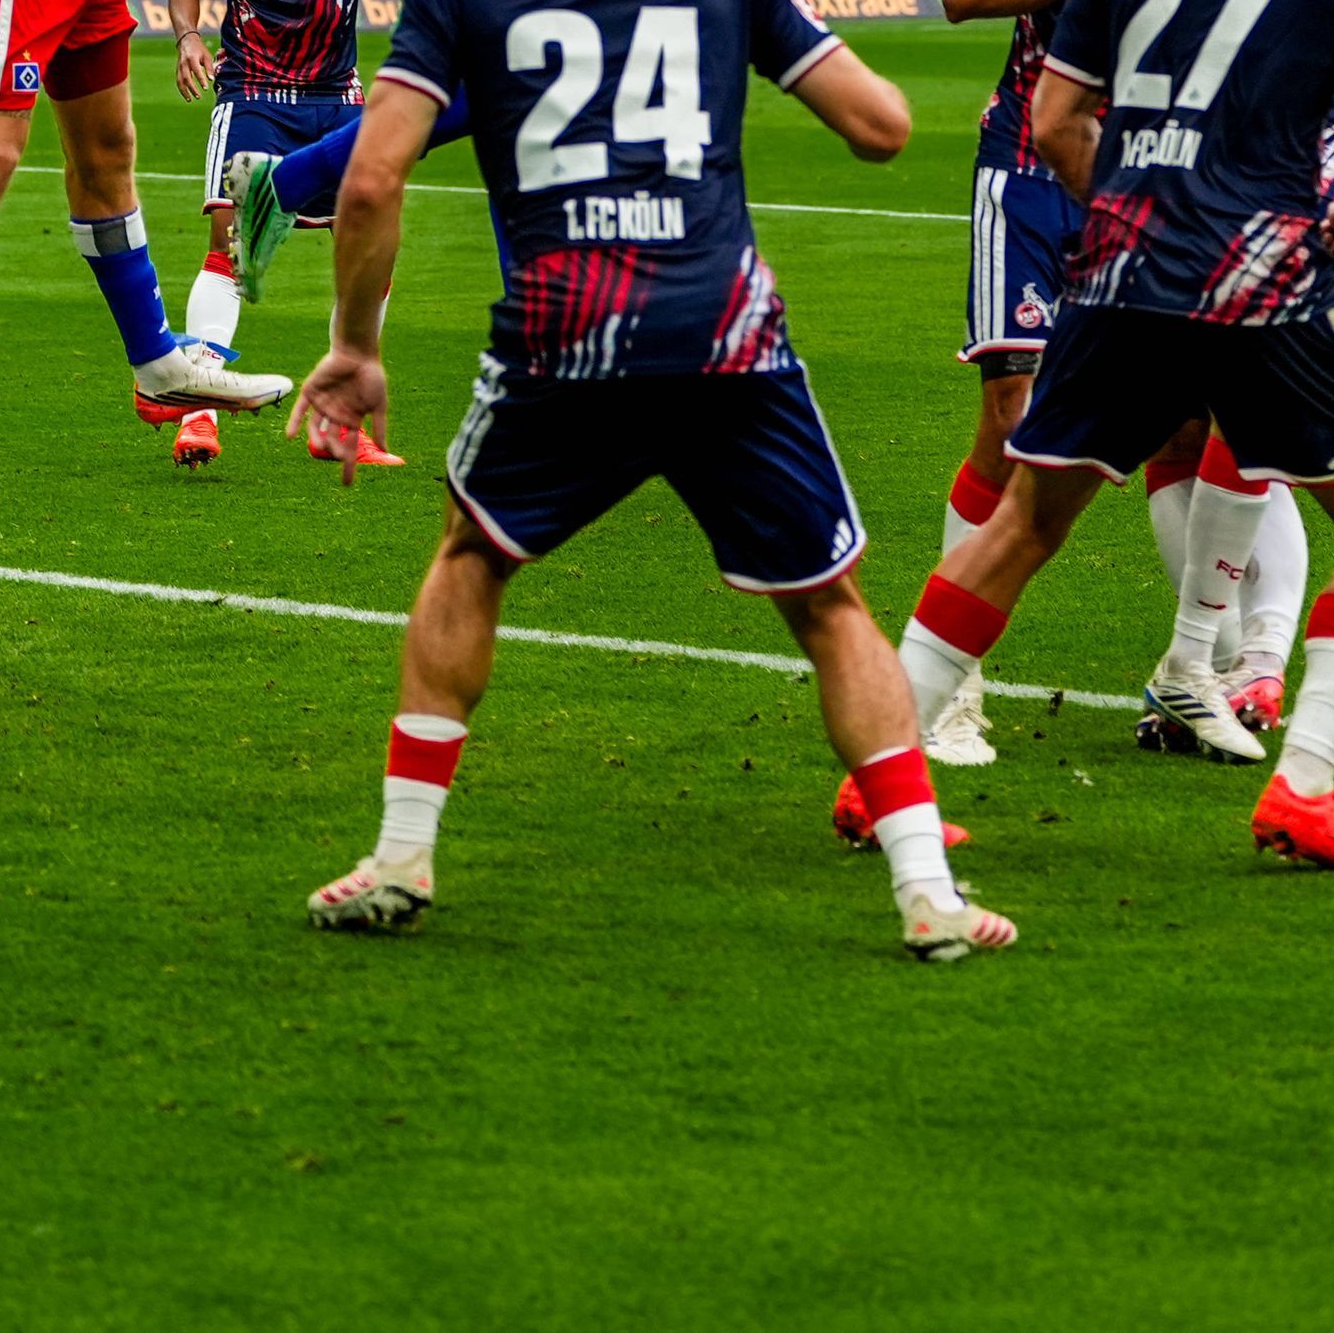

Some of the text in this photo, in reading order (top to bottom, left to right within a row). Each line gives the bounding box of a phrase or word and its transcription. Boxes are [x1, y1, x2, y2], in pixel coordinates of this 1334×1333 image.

[506, 6, 713, 193] 24
[618, 190, 685, 240] KÖLN
[1216, 559, 1244, 580] FC
